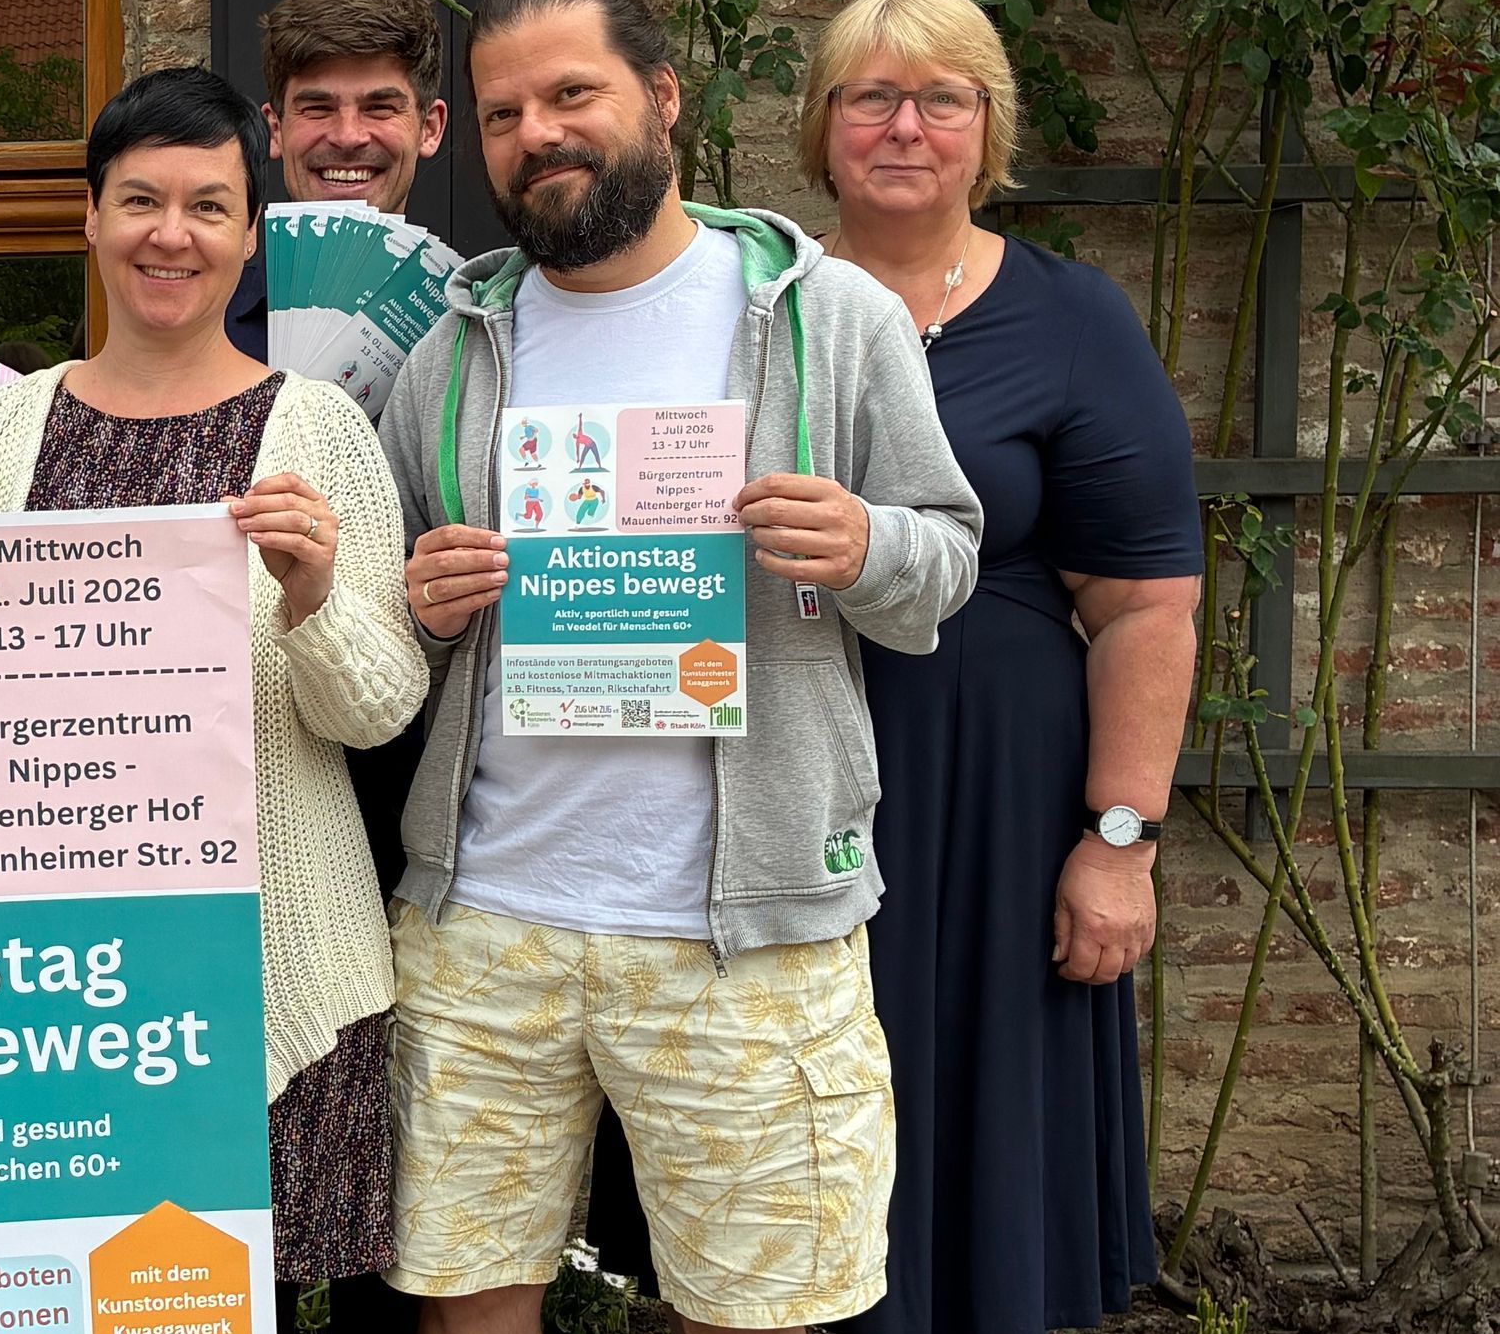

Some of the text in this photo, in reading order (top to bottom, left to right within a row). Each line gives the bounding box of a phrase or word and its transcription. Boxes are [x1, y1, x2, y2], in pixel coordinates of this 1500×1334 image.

[408, 290, 440, 324] beweg
[361, 346, 393, 377] 13 17 Uhr
[655, 410, 707, 420] Mittwoch
[651, 424, 714, 435] 1. Juli 2026
[653, 440, 710, 449] 13 17 Uhr
[639, 470, 723, 482] Bürgerzentrum
[656, 485, 696, 496] Nippes
[636, 498, 726, 512] Altenberger Hof
[622, 513, 737, 526] Mauenheimer Str. 92
[547, 546, 696, 571] Aktionstag
[19, 580, 74, 606] Juli
[83, 578, 162, 603] 2026
[520, 574, 726, 601] Nippes bewegt
[555, 609, 689, 620] Aktiv, sportlich und gesund
[54, 624, 86, 649] 17
[96, 622, 152, 647] Uhr
[552, 622, 692, 631] im Veedel für Menschen 60+
[577, 658, 673, 668] Beratungsangeboten
[507, 670, 671, 679] und kostenlose Mitmachaktionen
[507, 684, 671, 694] z.B. Fitness, Tanzen, Rikschafahrt
[575, 705, 587, 713] ZUG
[599, 705, 612, 713] ZUG
[710, 704, 742, 726] rahm
[9, 757, 117, 790] Nippes
[147, 795, 204, 821] Hof
[137, 843, 191, 866] Str.
[200, 840, 238, 864] 92
[12, 1114, 111, 1146] gesund
[69, 1155, 121, 1178] 60+
[130, 1264, 210, 1284] mit dem
[97, 1290, 245, 1316] Kunstorchester
